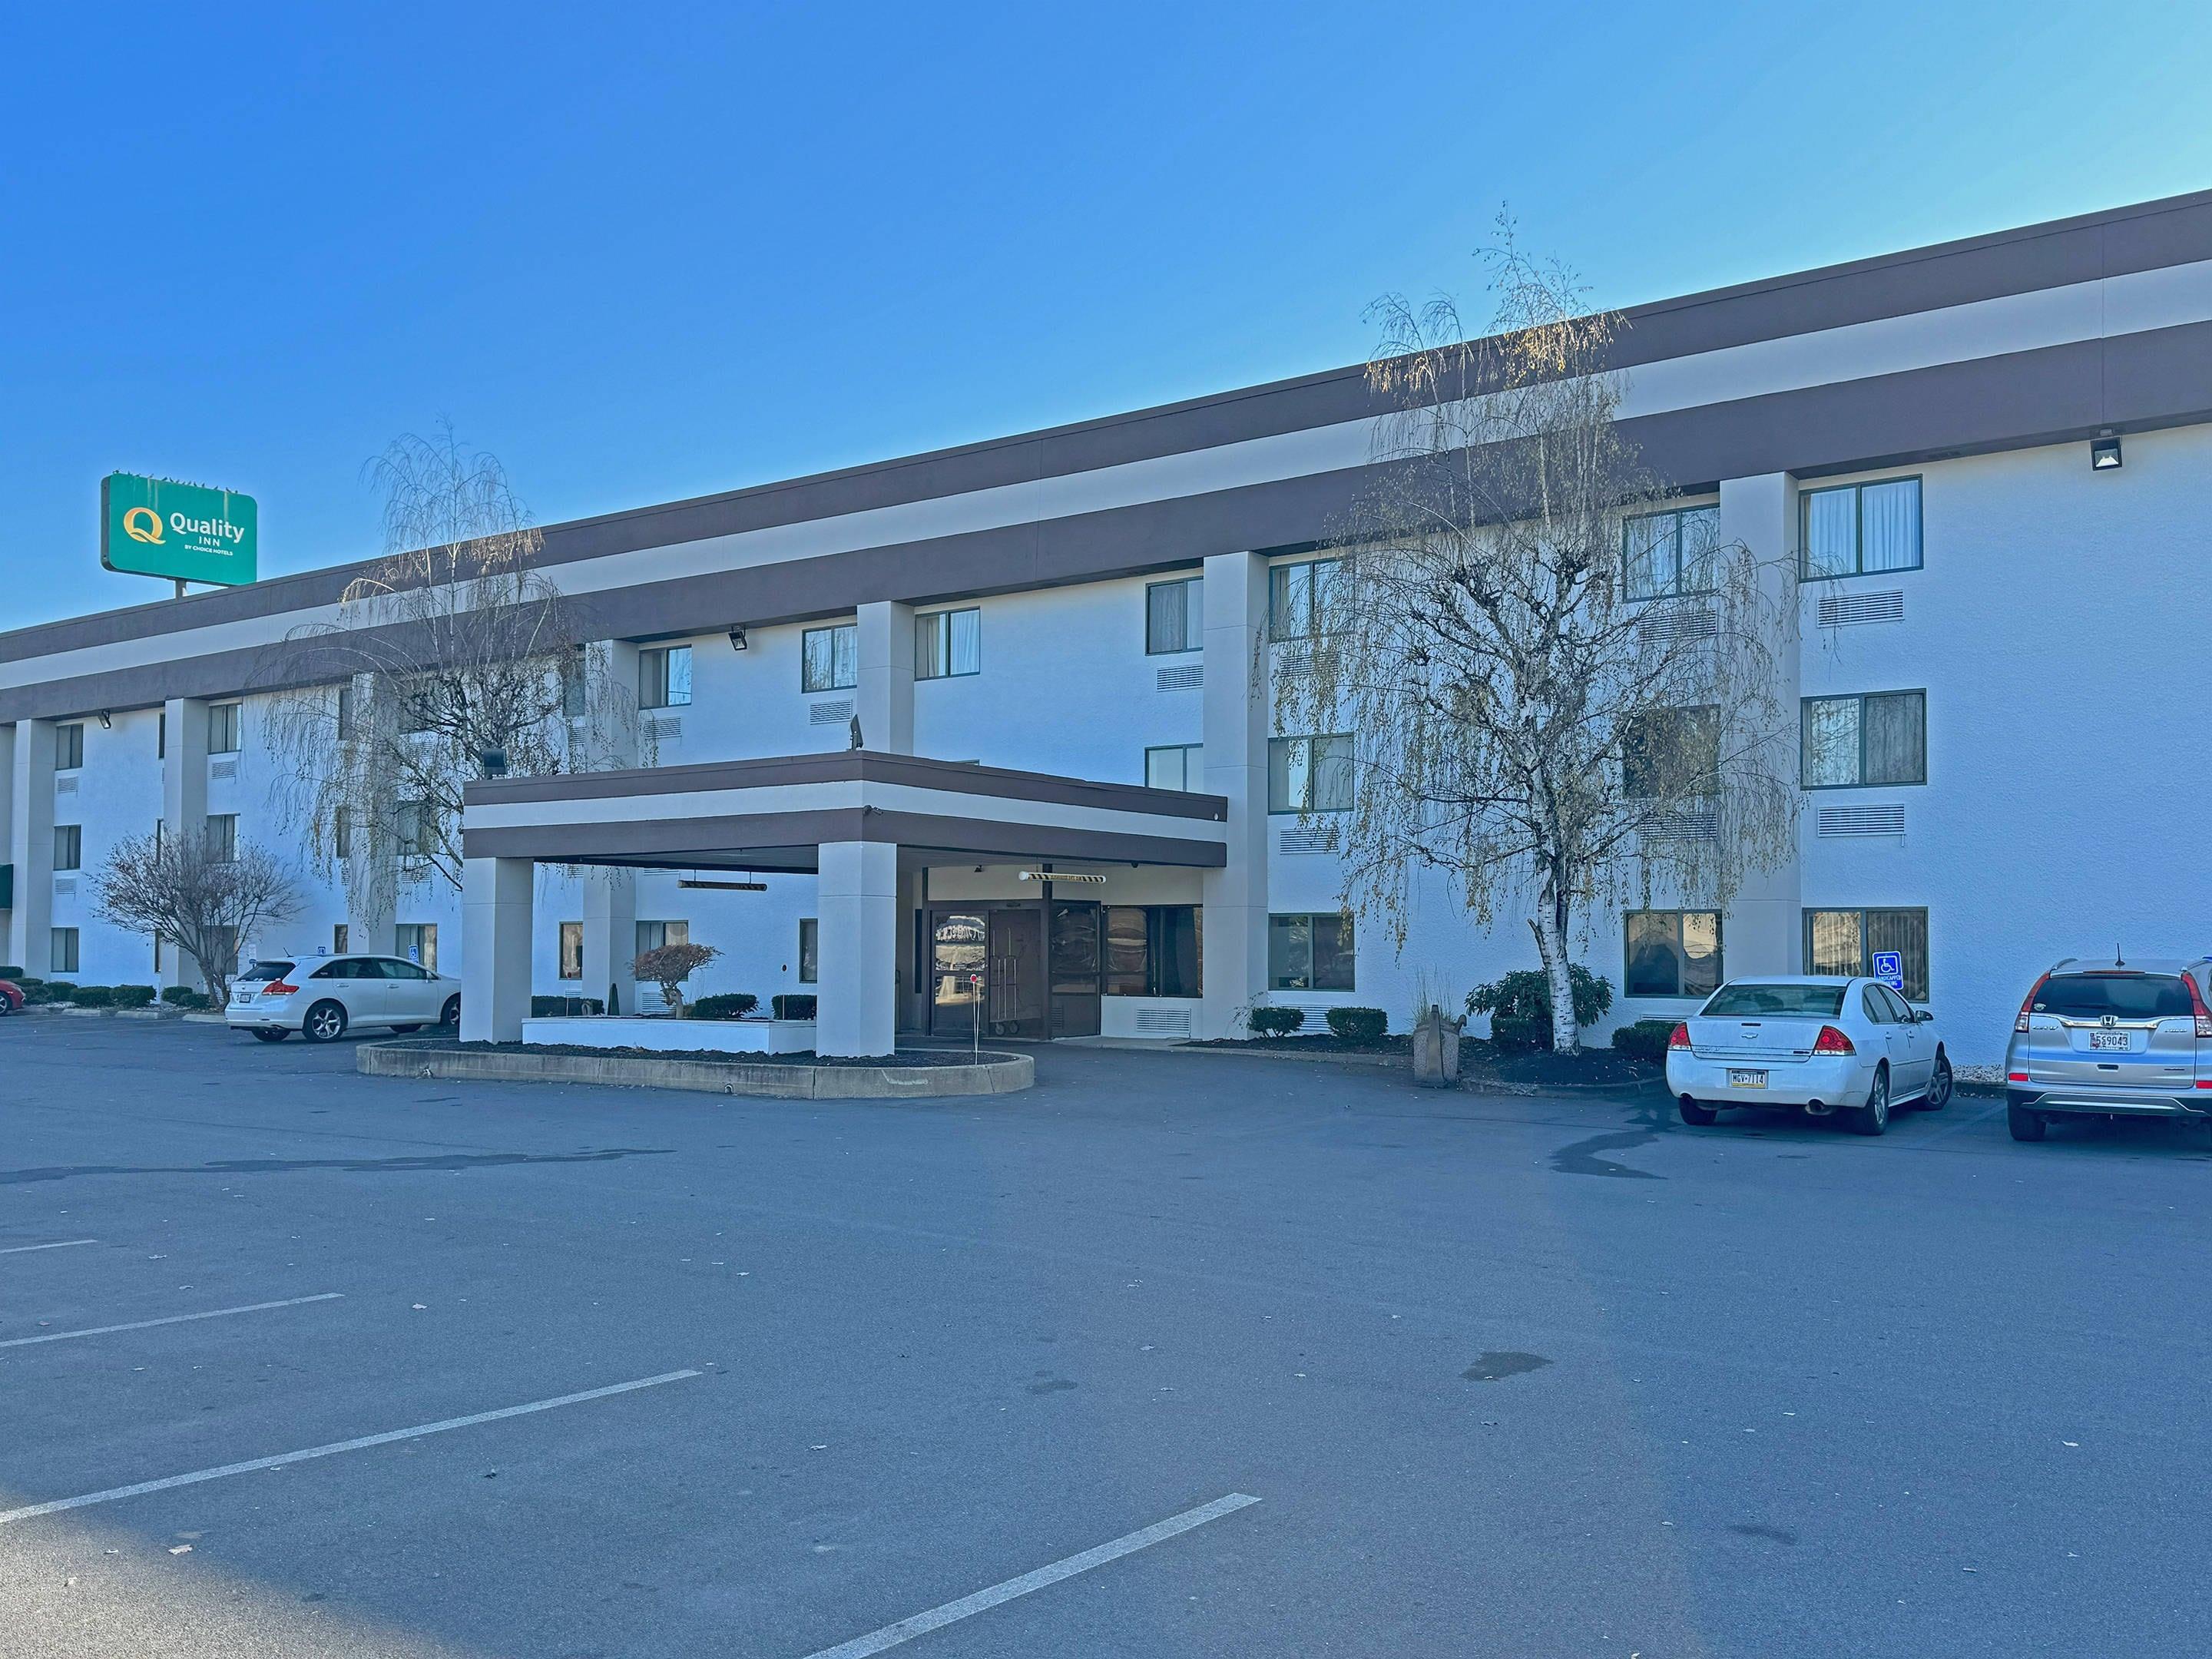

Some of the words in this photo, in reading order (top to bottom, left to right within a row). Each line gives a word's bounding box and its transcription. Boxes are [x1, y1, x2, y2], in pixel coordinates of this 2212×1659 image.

[124, 507, 166, 545] Q
[170, 512, 244, 543] Quality
[198, 536, 220, 547] INN
